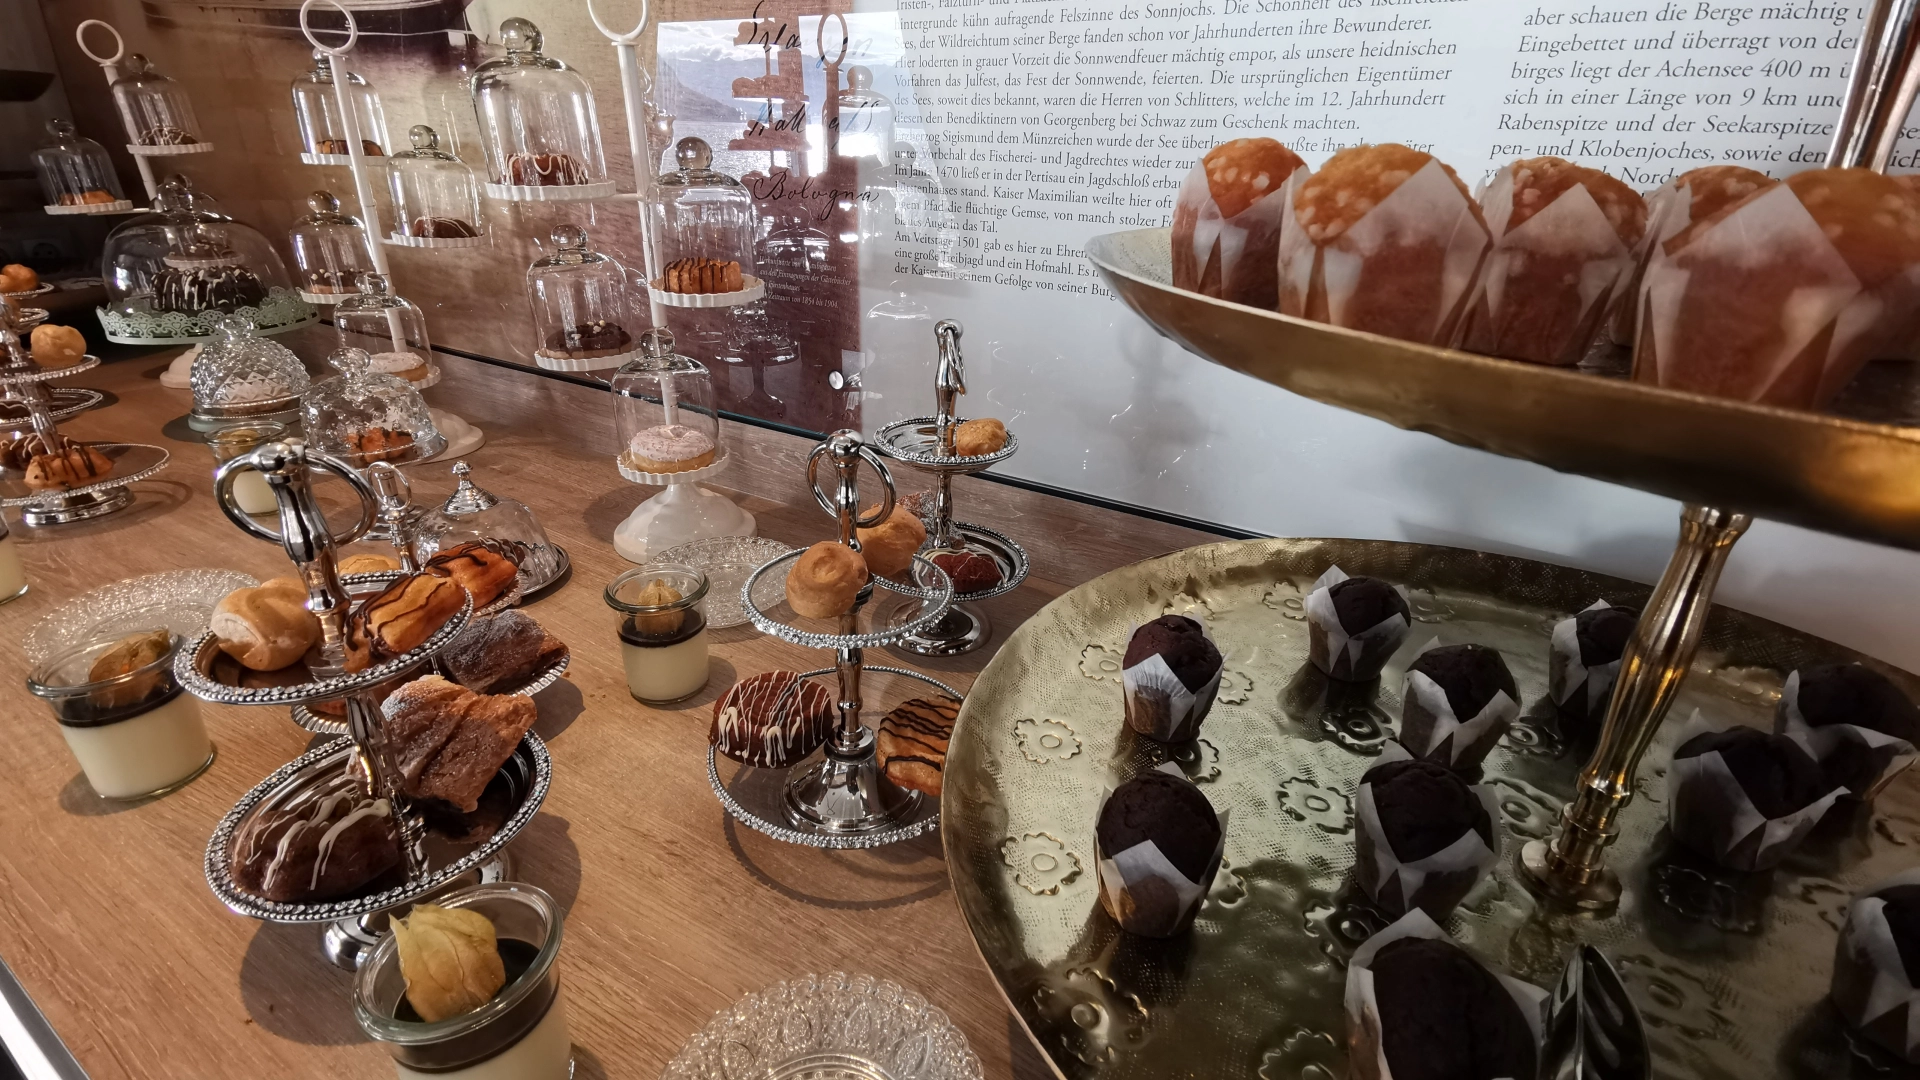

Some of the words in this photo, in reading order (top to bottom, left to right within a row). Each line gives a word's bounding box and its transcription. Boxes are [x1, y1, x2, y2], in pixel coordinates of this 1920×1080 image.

[963, 12, 988, 27] kühn
[995, 9, 1054, 29] aufragende
[1060, 7, 1113, 22] Felszinne
[1120, 4, 1139, 20] des
[1145, 2, 1215, 22] Sonnjochs.
[1224, 0, 1249, 14] Die
[1524, 7, 1565, 26] aber
[1569, 5, 1647, 24] schauen
[1656, 2, 1687, 21] die
[1694, 2, 1753, 26] Berge
[1759, 2, 1850, 26] mächtig
[920, 35, 935, 48] der
[938, 33, 1009, 48] Wildreichtum
[1013, 33, 1045, 46] seiner
[1048, 31, 1080, 48] Berge
[1084, 28, 1123, 43] fanden
[1128, 26, 1163, 42] schon
[1169, 30, 1190, 40] vor
[1192, 21, 1292, 43] Jahrhunderten
[1298, 18, 1328, 35] ihre
[1332, 14, 1431, 33] Bewunderer.
[919, 54, 958, 68] loderten
[963, 55, 972, 66] in
[976, 58, 1008, 71] grauer
[1012, 53, 1050, 66] Vorzeit
[1054, 51, 1070, 65] die
[1074, 48, 1168, 65] Sonnwendfeuer
[1172, 47, 1225, 67] mächtig
[1229, 50, 1276, 66] empor,
[1282, 43, 1301, 60] als
[1307, 48, 1354, 59] unsere
[1359, 38, 1456, 57] heidnischen
[1518, 34, 1627, 58] Eingebettet
[1634, 30, 1676, 50] und
[1682, 30, 1770, 55] überragt
[1779, 37, 1816, 48] von
[894, 74, 940, 86] Vorfahren
[946, 73, 961, 86] das
[964, 72, 999, 89] Julfest,
[1004, 72, 1021, 86] das
[1026, 73, 1047, 86] Fest
[1052, 72, 1070, 85] der
[1075, 70, 1146, 86] Sonnwende,
[1152, 70, 1202, 84] feierten.
[1210, 70, 1234, 84] Die
[1241, 66, 1348, 88] ursprünglichen
[1356, 66, 1452, 87] Eigentümer
[1511, 61, 1564, 84] birges
[1570, 60, 1612, 84] liegt
[1618, 60, 1651, 78] der
[1654, 58, 1753, 77] Achensee
[1760, 58, 1802, 77] 400
[895, 93, 908, 105] des
[912, 93, 934, 106] Sees,
[938, 94, 968, 105] soweit
[971, 92, 990, 105] dies
[994, 92, 1039, 107] bekannt,
[1044, 97, 1075, 106] waren
[1080, 92, 1097, 106] die
[1102, 93, 1142, 106] Herren
[1148, 97, 1169, 106] von
[1174, 91, 1237, 108] Schlitters,
[1244, 91, 1290, 106] welche
[1295, 92, 1313, 106] im
[1322, 92, 1342, 106] 12.
[1347, 89, 1446, 110] Jahrhundert
[1504, 87, 1538, 104] sich
[1545, 89, 1563, 104] in
[1571, 89, 1619, 104] einer
[1626, 88, 1686, 111] Länge
[1696, 94, 1731, 105] von
[1740, 88, 1755, 106] 9
[1762, 86, 1796, 106] km
[894, 111, 922, 124] diesen
[926, 111, 943, 123] den
[947, 111, 1016, 124] Benediktinern
[1021, 117, 1039, 125] von
[1044, 112, 1116, 131] Georgenberg
[1120, 113, 1137, 126] bei
[1141, 113, 1186, 127] Schwaz
[1190, 119, 1217, 128] zum
[1223, 114, 1289, 128] Geschenk
[1293, 114, 1359, 129] machten.
[1497, 113, 1608, 136] Rabenspitze
[1616, 114, 1656, 131] und
[1662, 114, 1696, 132] der
[1703, 114, 1834, 140] Seekarspitze
[942, 130, 994, 146] Sigismund
[997, 130, 1018, 144] dem
[1022, 132, 1092, 146] Münzreichen
[1096, 133, 1132, 147] wurde
[1136, 133, 1154, 147] der
[1158, 134, 1178, 148] See
[1489, 145, 1530, 160] pen-
[1537, 139, 1574, 156] und
[1578, 139, 1714, 163] Klobenjoches,
[1722, 145, 1782, 161] sowie
[1788, 144, 1826, 164] den
[970, 148, 985, 161] des
[989, 150, 1037, 163] Fischerei-
[1041, 151, 1062, 164] und
[1064, 152, 1128, 169] Jagdrechtes
[1132, 154, 1172, 168] wieder
[894, 164, 907, 175] Im
[935, 166, 958, 178] 1470
[962, 166, 979, 179] ließ
[994, 169, 1003, 180] in
[1006, 168, 1022, 181] der
[1025, 170, 1065, 183] Pertisau
[1068, 172, 1084, 184] ein
[1086, 172, 1150, 190] Jagdschloß
[752, 168, 879, 221] Bologna
[960, 185, 989, 197] stand.
[994, 186, 1024, 199] Kaiser
[1028, 188, 1088, 203] Maximilian
[1092, 192, 1125, 206] weilte
[1129, 193, 1152, 207] hier
[1156, 195, 1172, 208] oft
[948, 202, 962, 214] die
[966, 201, 1007, 220] flüchtige
[1012, 205, 1048, 221] Gemse,
[1054, 212, 1072, 220] von
[1078, 211, 1114, 224] manch
[1119, 213, 1156, 226] stolzer
[962, 219, 978, 231] das
[980, 220, 997, 233] Tal.
[895, 231, 910, 242] Am
[956, 234, 979, 248] 1501
[984, 238, 1000, 253] gab
[1017, 240, 1037, 254] hier
[1040, 247, 1052, 255] zu
[895, 250, 912, 258] eine
[986, 256, 1005, 268] und
[1007, 258, 1022, 269] ein
[1025, 259, 1074, 275] Hofmahl.
[895, 262, 908, 273] der
[911, 265, 938, 278] Kaiser
[959, 271, 991, 283] seinem
[995, 273, 1032, 291] Gefolge
[1035, 281, 1054, 290] von
[1057, 281, 1088, 294] seiner
